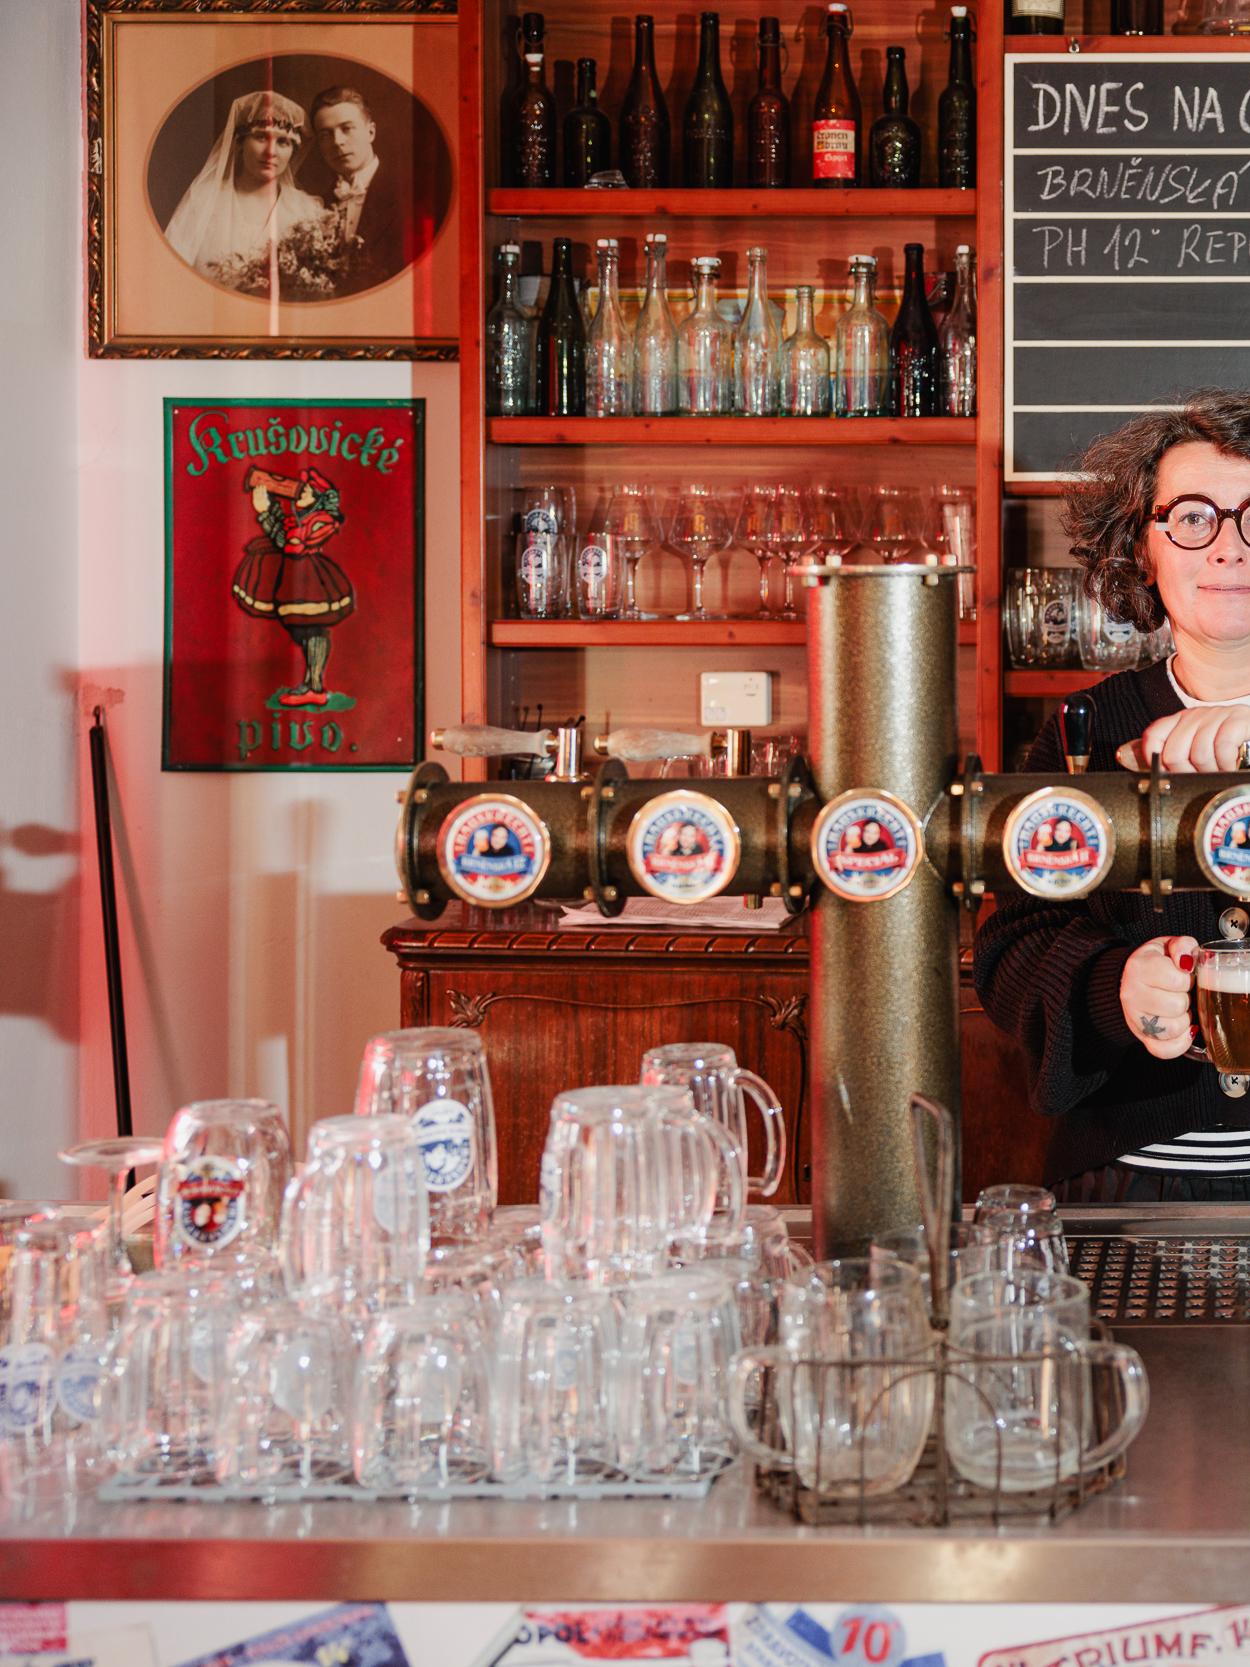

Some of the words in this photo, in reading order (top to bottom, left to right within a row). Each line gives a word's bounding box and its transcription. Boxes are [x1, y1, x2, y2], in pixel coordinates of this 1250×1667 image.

[1027, 81, 1150, 136] DNES
[1173, 84, 1225, 134] NA
[1031, 225, 1087, 269] PH
[186, 410, 404, 476] Krušovické
